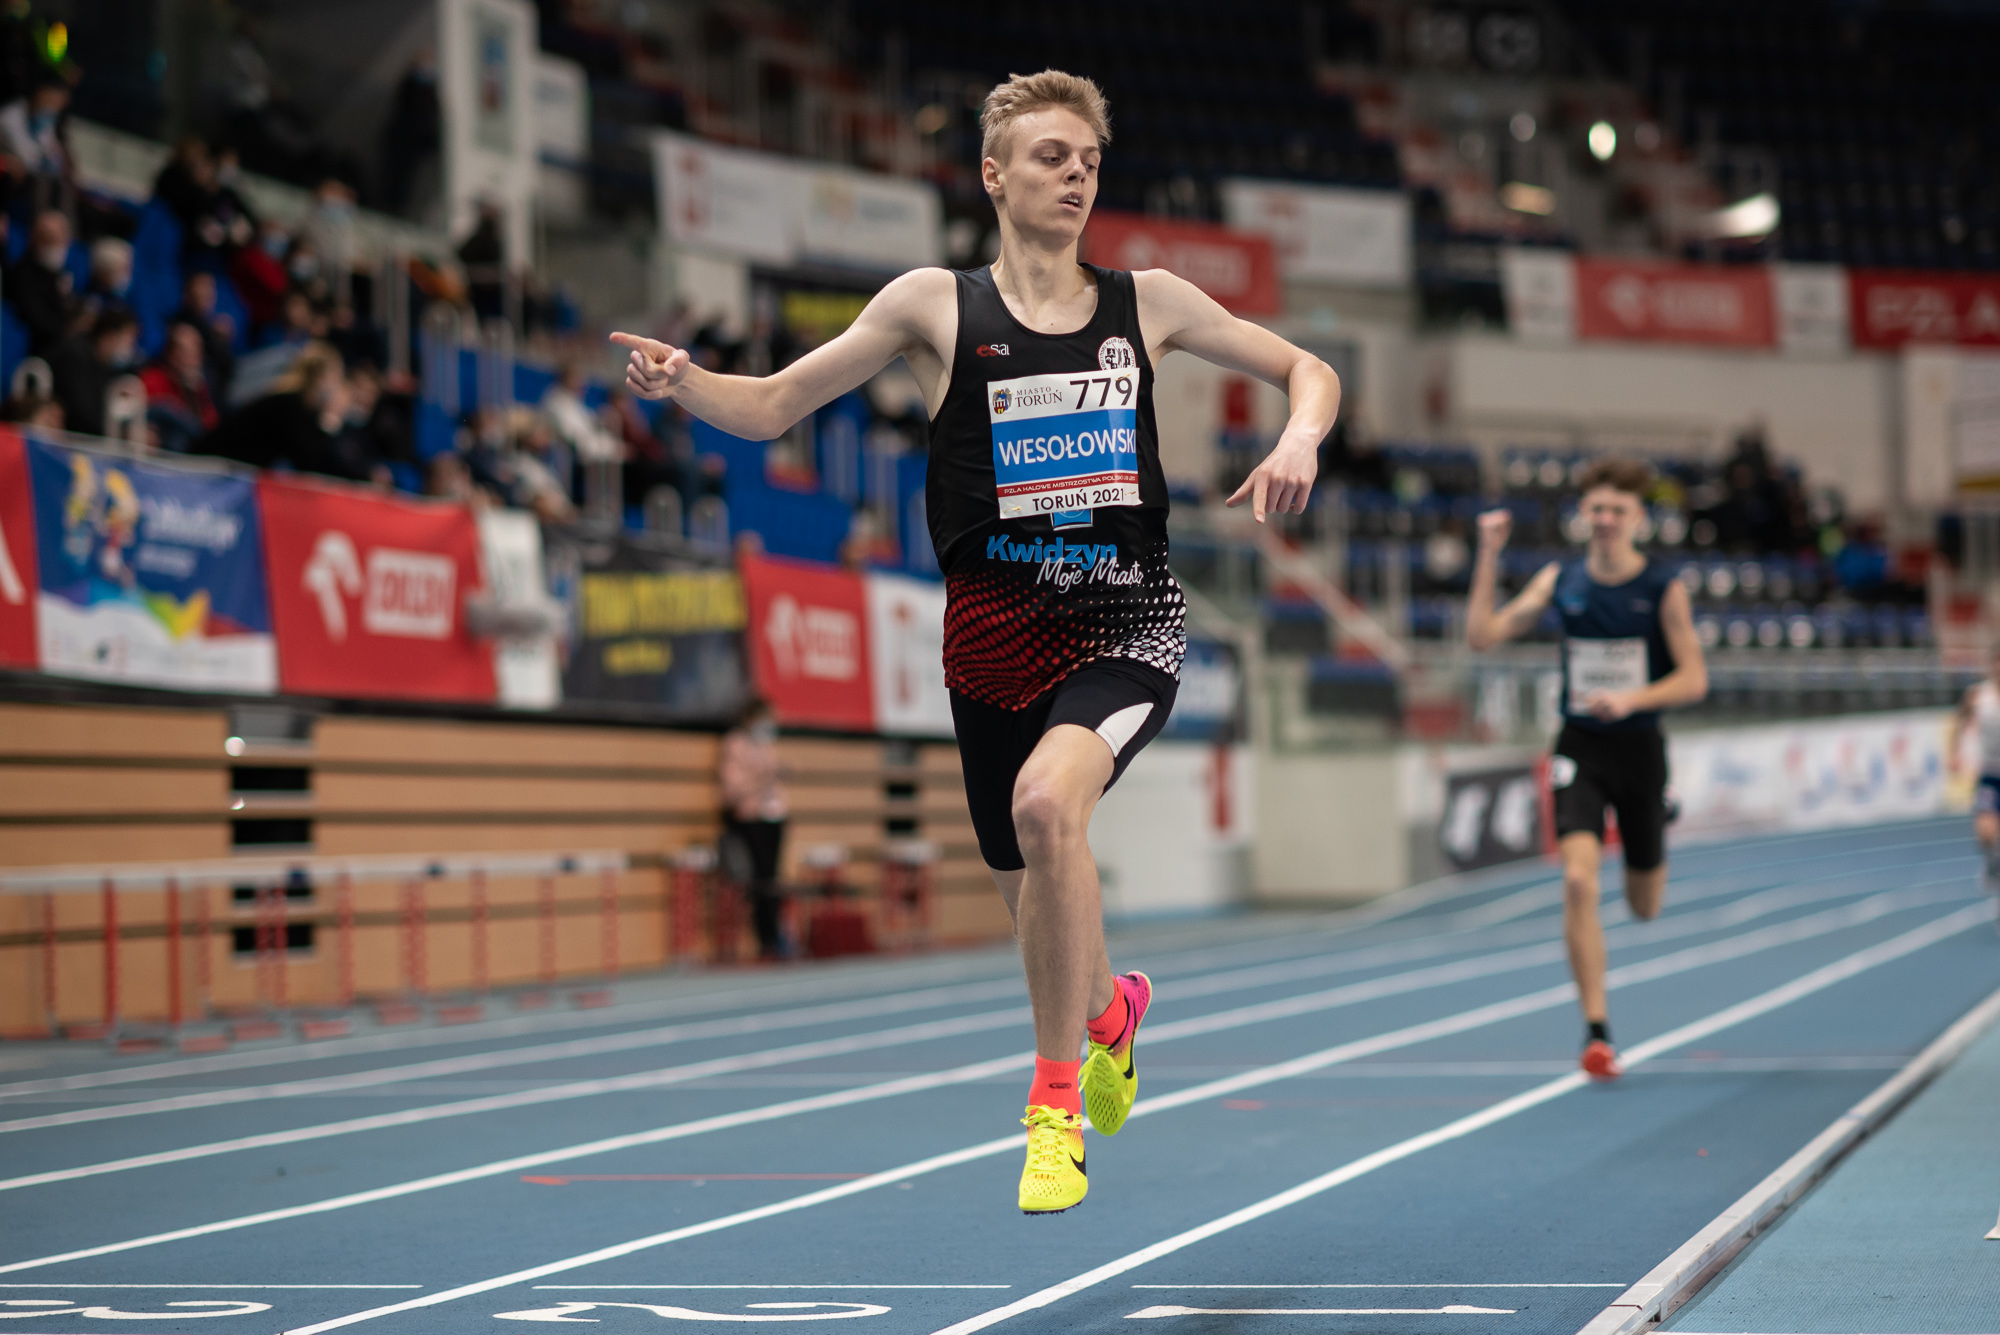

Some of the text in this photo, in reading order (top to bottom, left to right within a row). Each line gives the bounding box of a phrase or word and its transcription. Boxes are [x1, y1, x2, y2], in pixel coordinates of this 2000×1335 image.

[1015, 389, 1063, 408] TORUŃ
[1016, 386, 1052, 396] MIASTO
[1069, 376, 1133, 410] 779
[1022, 483, 1051, 491] HALOWE
[1052, 477, 1102, 488] MISTRZOSTWA
[1032, 487, 1124, 512] TORUŃ 2021
[986, 533, 1118, 571] Kwidzyn
[1036, 557, 1084, 594] Moje
[491, 1300, 892, 1324] 2
